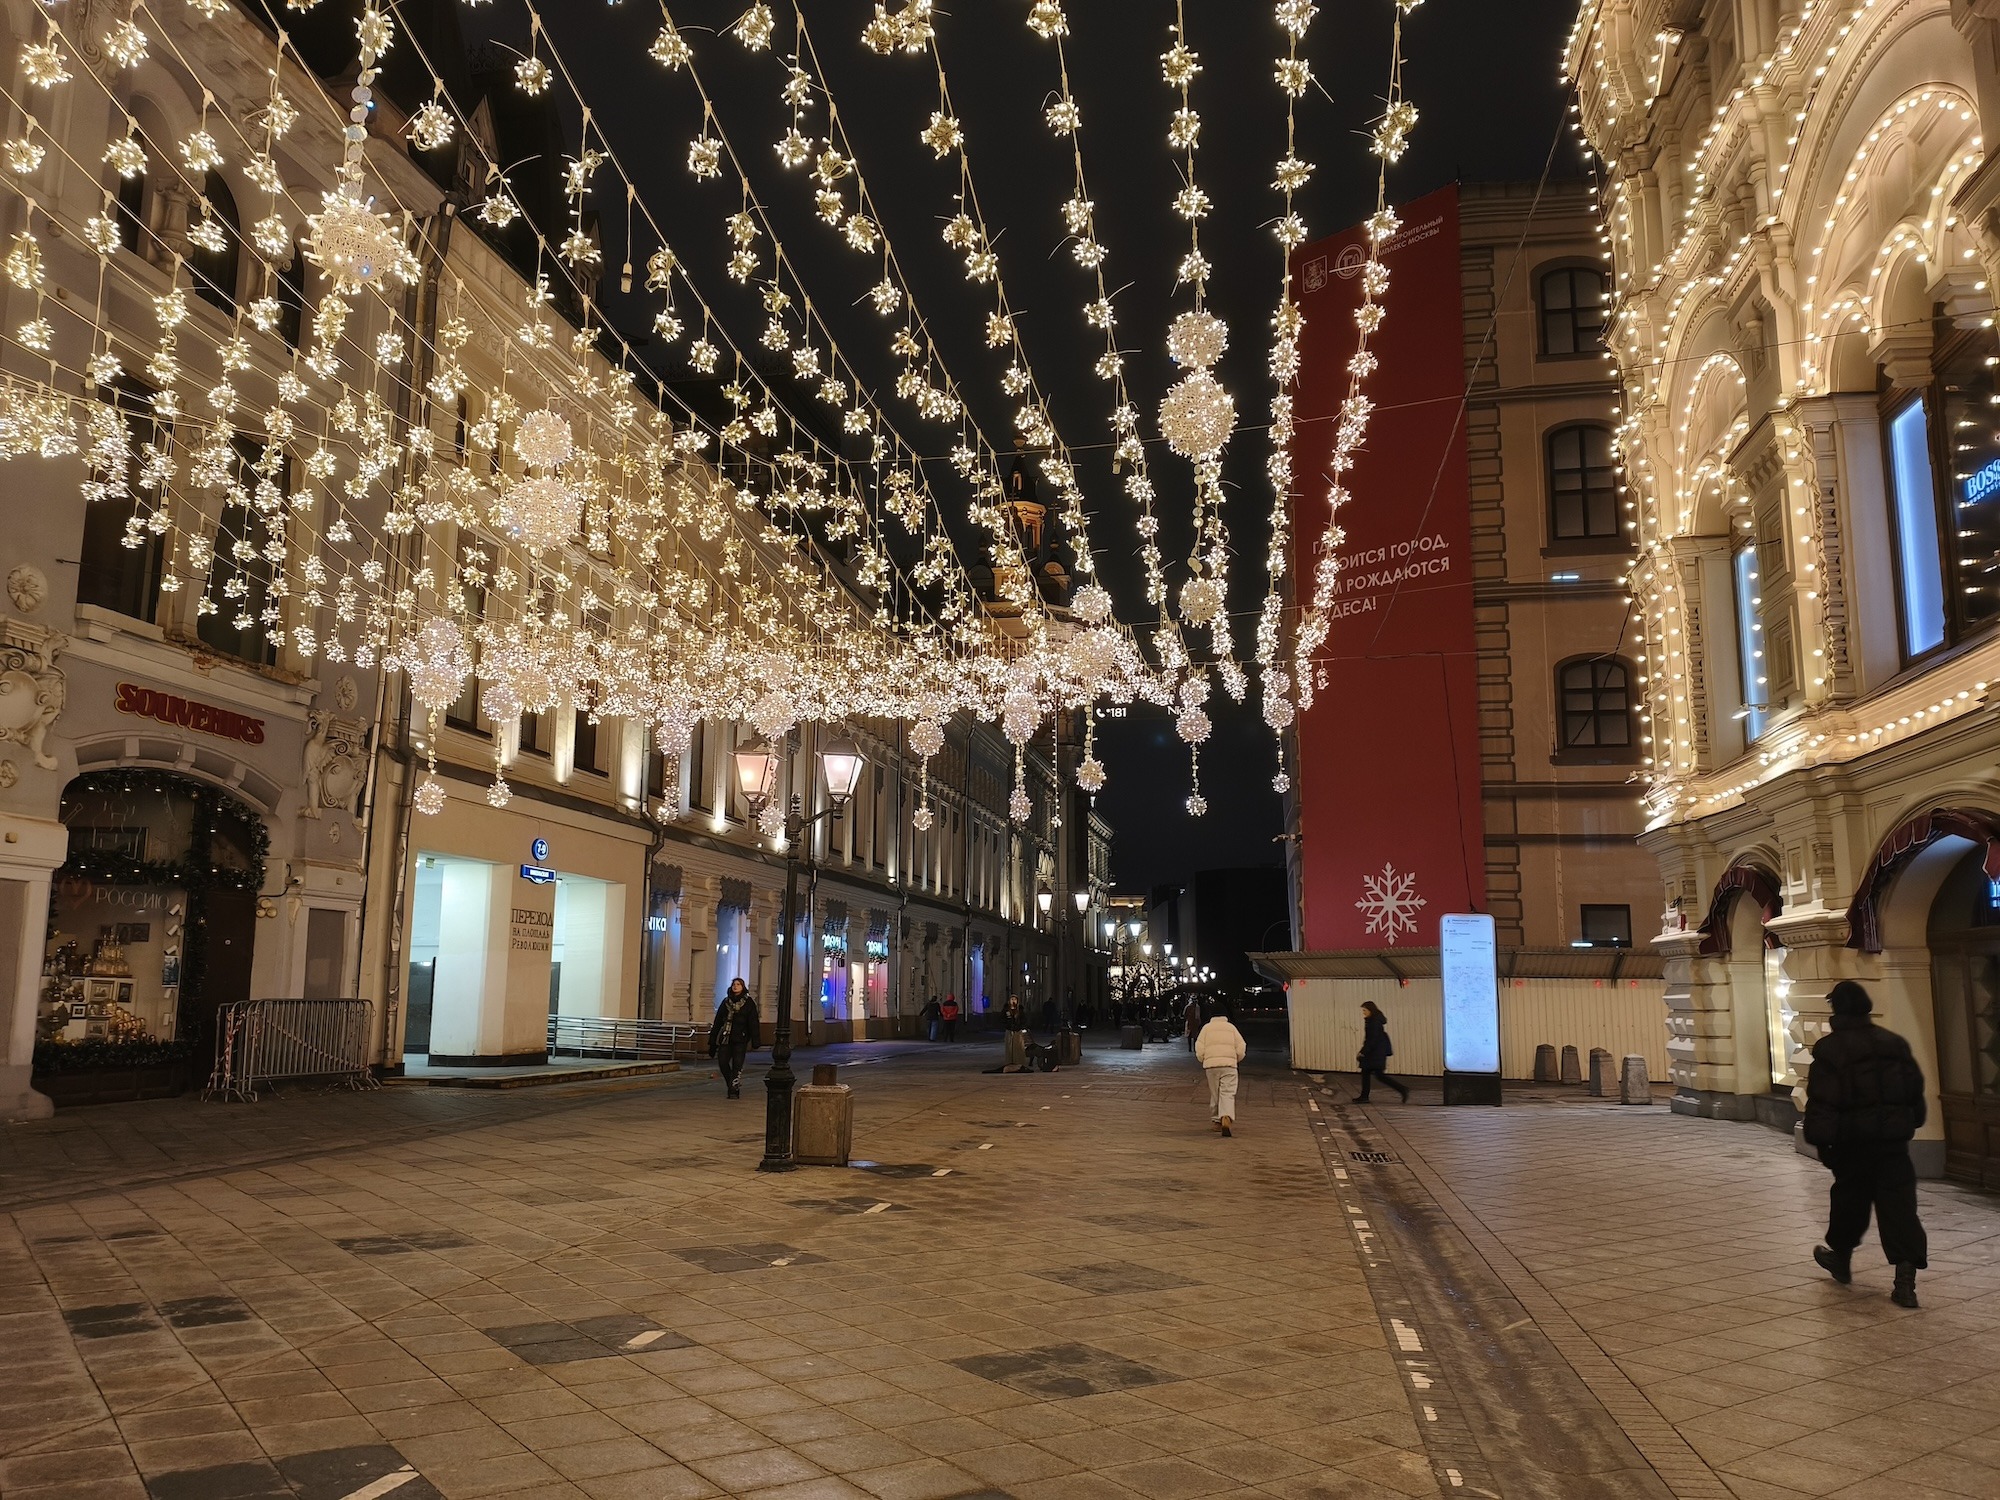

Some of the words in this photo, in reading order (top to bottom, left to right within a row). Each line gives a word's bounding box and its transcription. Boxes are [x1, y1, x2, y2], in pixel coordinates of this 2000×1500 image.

[1370, 215, 1444, 250] ДОСТРОИТЕЛЬНЫЙ
[1408, 227, 1440, 245] МОСКВЫ
[1313, 547, 1385, 578] СОИТСЯ
[1390, 534, 1449, 559] ГОРОД,
[1347, 556, 1450, 592] РОЖДАЮТСЯ
[1319, 596, 1377, 620] УДЕСА!
[114, 682, 265, 745] SOUVENIRS
[96, 887, 169, 910] РОССИЮ
[511, 908, 553, 927] ПЕРЕХОД
